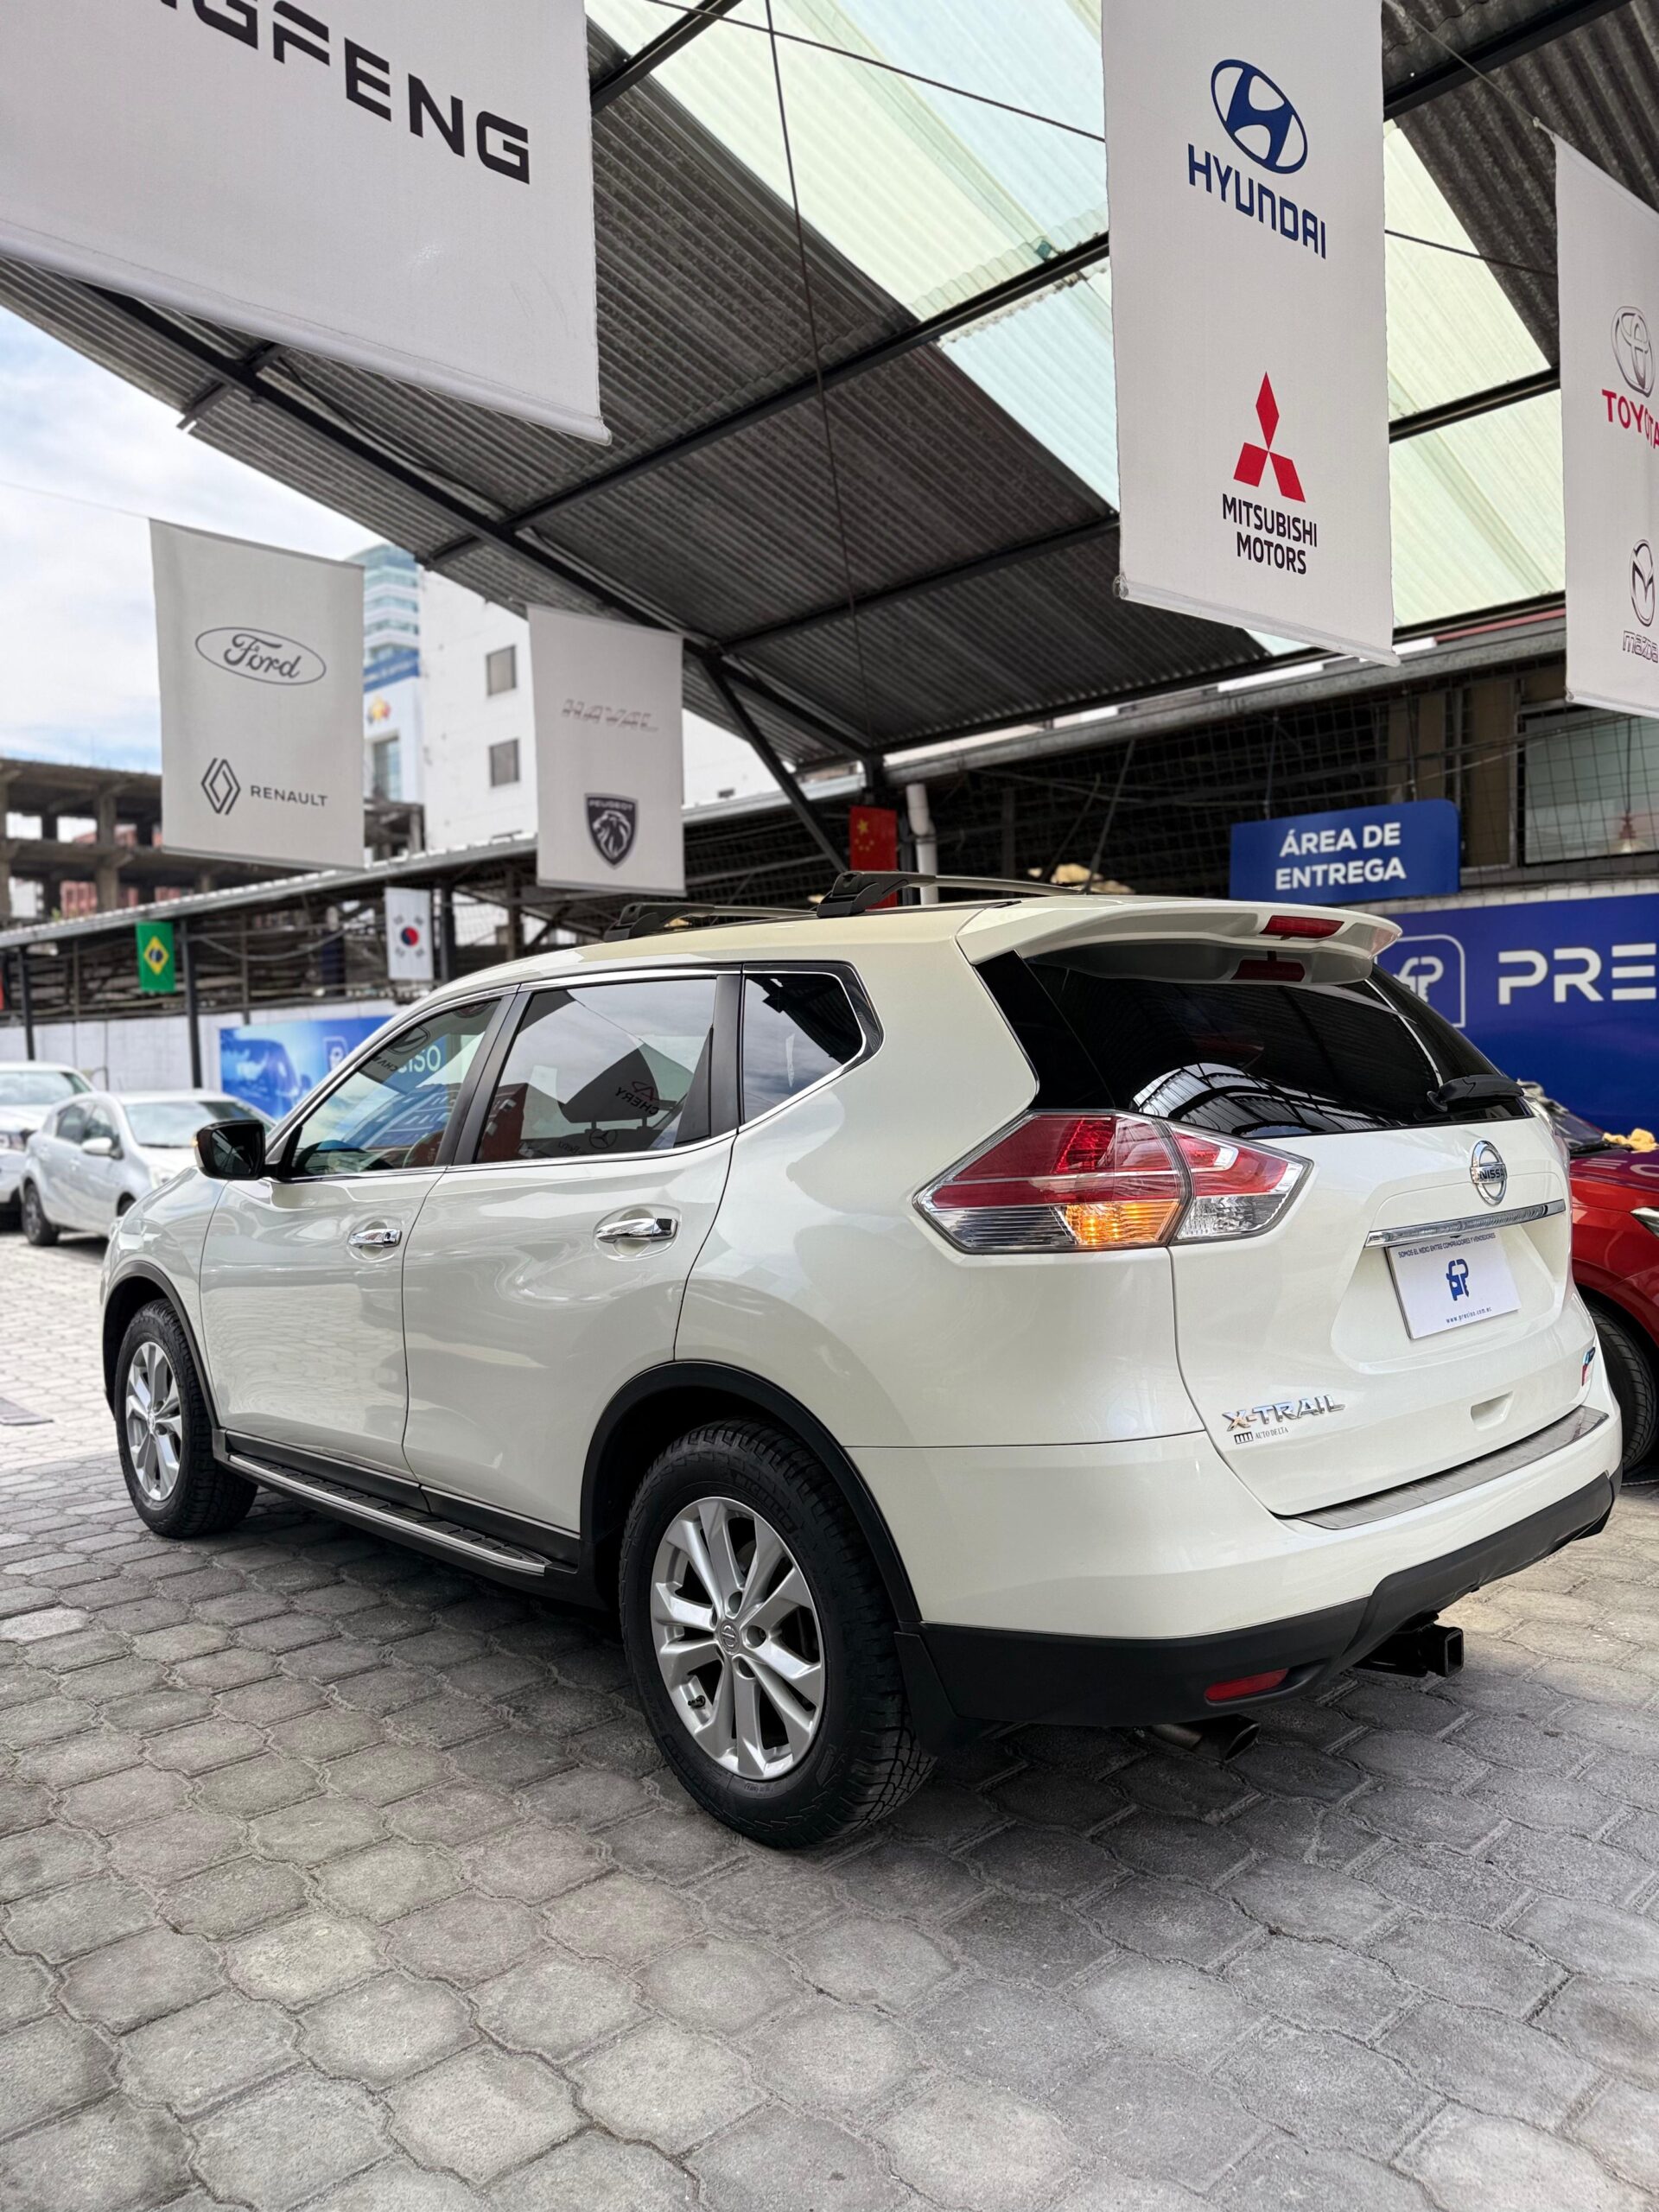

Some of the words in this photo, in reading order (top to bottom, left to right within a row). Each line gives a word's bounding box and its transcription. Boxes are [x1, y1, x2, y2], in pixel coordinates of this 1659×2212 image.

[161, 0, 531, 185] GFENG
[1187, 143, 1327, 259] HYUNDAI
[1222, 493, 1318, 548] MITSUBISHI
[1236, 531, 1307, 575] MOTORS
[224, 633, 302, 678] Ford
[563, 698, 658, 733] HAVAL
[250, 785, 328, 807] RENAULT
[589, 798, 633, 811] PEUGEOT
[1279, 829, 1357, 858] ÁREA
[1363, 822, 1402, 849] DE
[1275, 857, 1407, 892] ENTREGA
[1498, 943, 1657, 1005] PRE
[1398, 1249, 1414, 1258] SOMOS
[1430, 1243, 1443, 1251] ENTRE
[1443, 1237, 1471, 1249] COMPRADORES
[1473, 1232, 1496, 1243] VENDEDORES
[1446, 1306, 1492, 1324] www.preciso.com.ec
[1222, 1394, 1345, 1432] X-TRAIL
[1255, 1431, 1270, 1440] AUTO
[1271, 1427, 1289, 1436] DELTA
